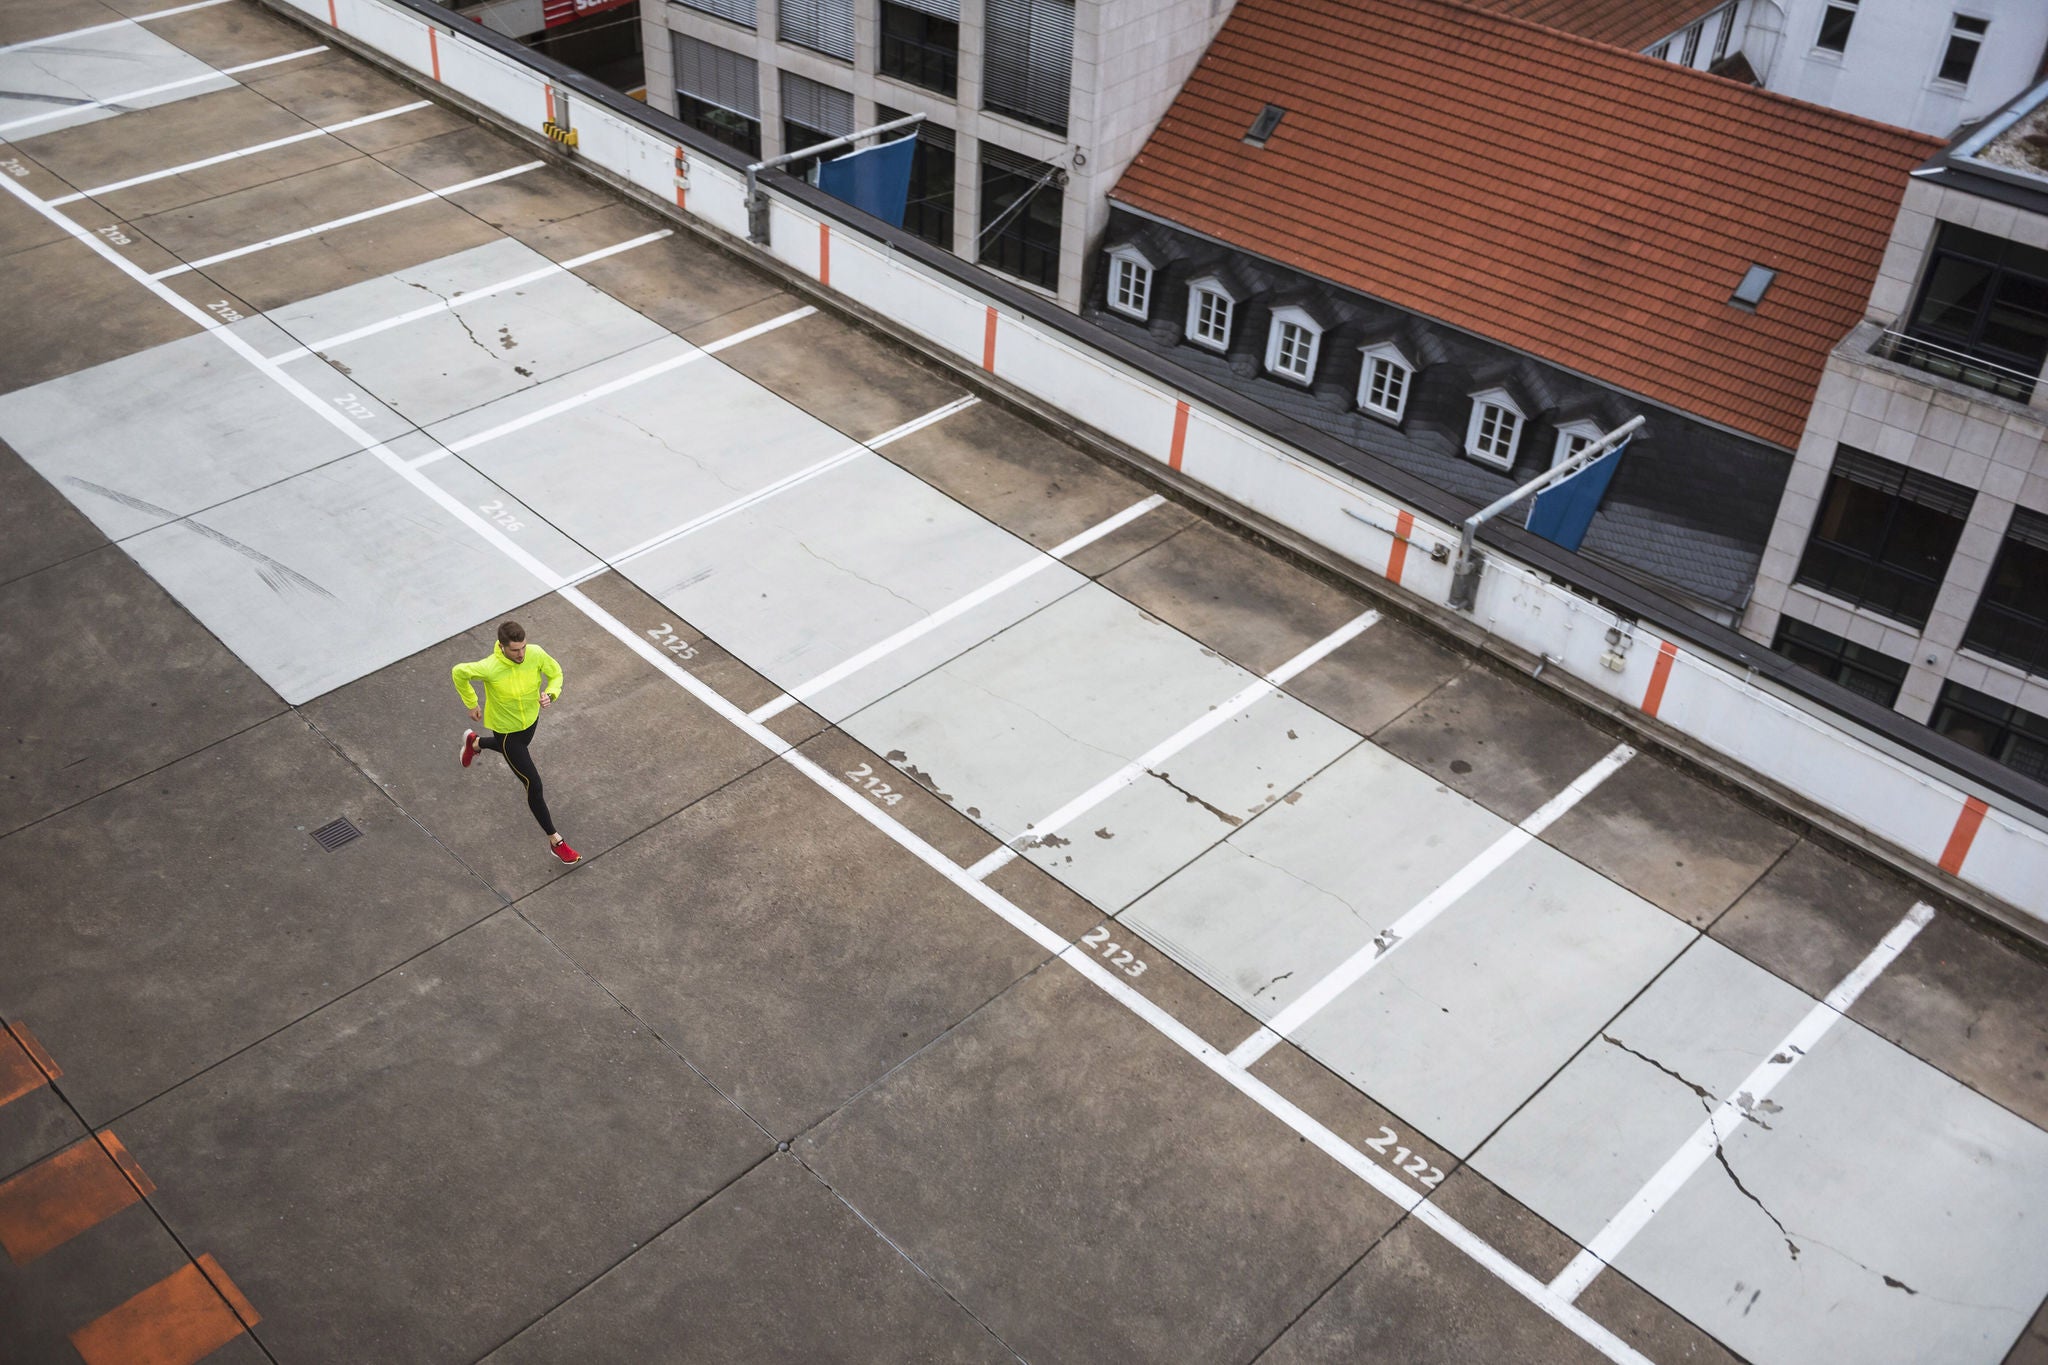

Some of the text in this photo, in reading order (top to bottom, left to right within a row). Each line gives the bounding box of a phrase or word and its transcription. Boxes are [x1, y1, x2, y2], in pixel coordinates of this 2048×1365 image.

[97, 225, 133, 246] 2129
[206, 300, 245, 322] 2128
[333, 393, 377, 420] 2127
[479, 499, 526, 532] 2126
[647, 622, 699, 660] 2125
[845, 762, 904, 806] 2124
[1081, 925, 1148, 977] 2123
[1364, 1125, 1445, 1190] 2122
